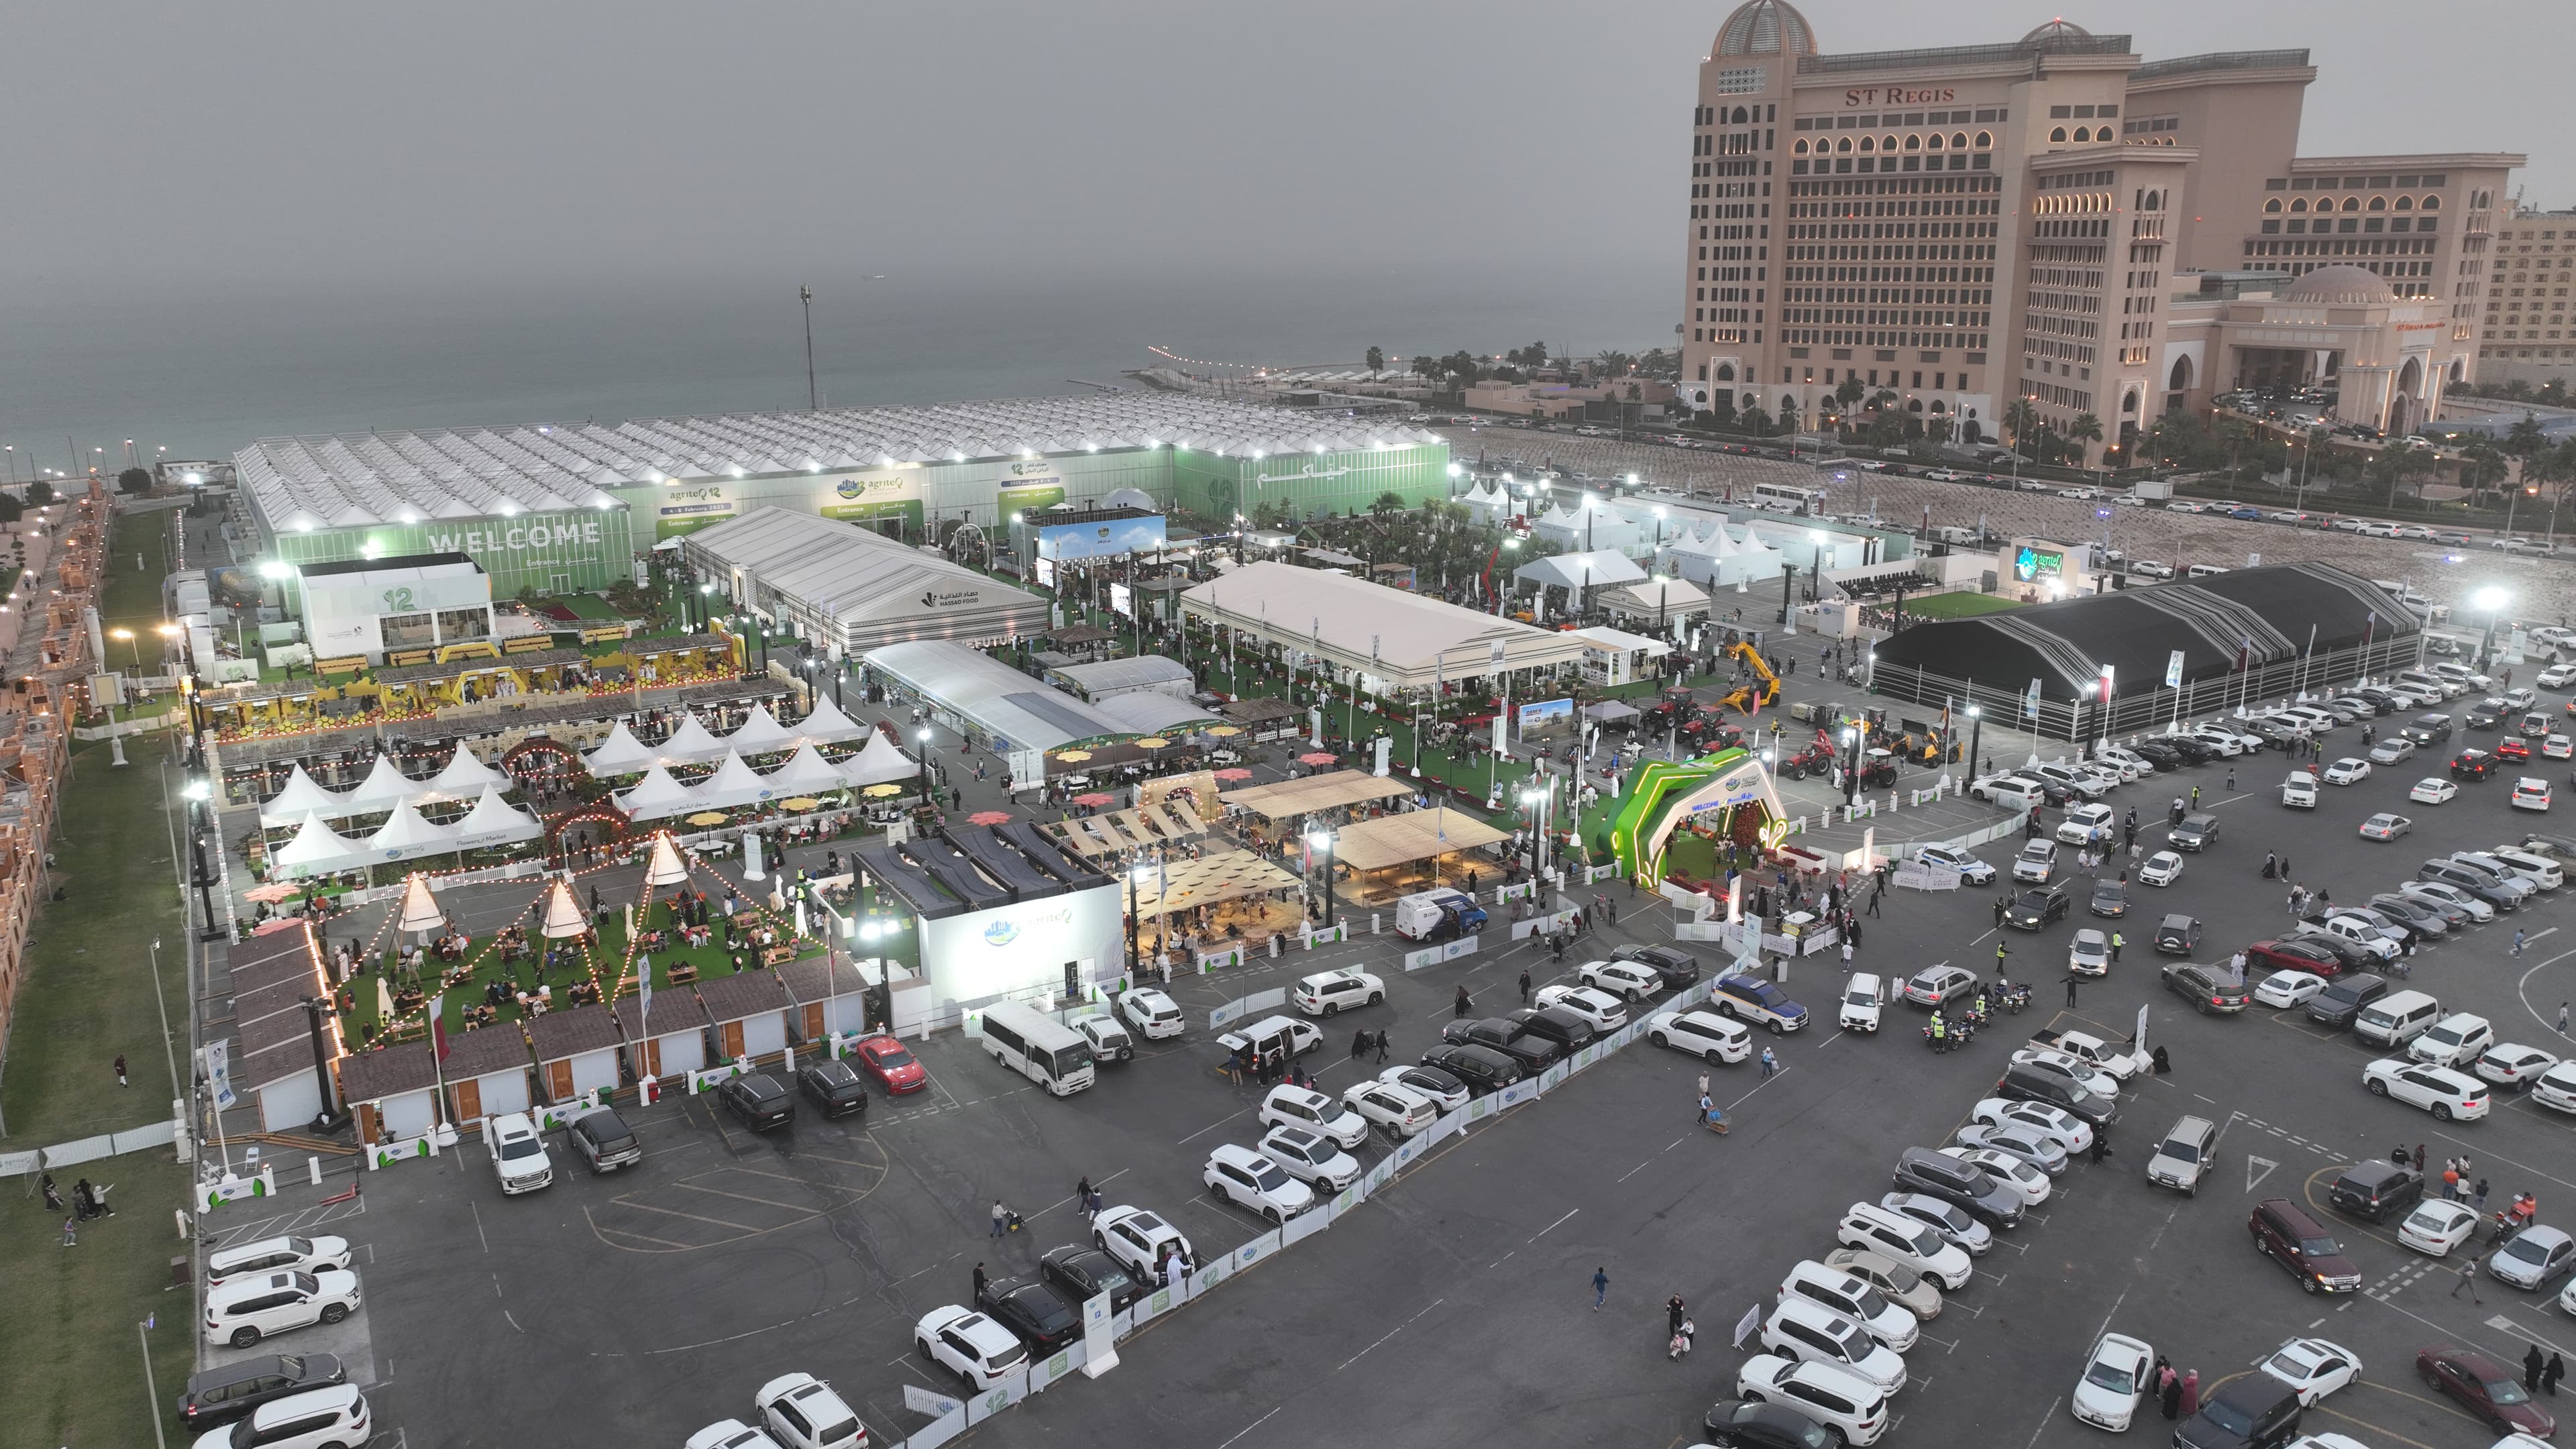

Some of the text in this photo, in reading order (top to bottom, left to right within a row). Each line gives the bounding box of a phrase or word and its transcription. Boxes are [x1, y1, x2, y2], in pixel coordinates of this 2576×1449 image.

[1886, 88, 1954, 104] REGIS
[869, 477, 903, 489] agriteQ
[670, 487, 721, 501] agriteQ 12
[429, 522, 600, 553] WELCOME
[526, 559, 559, 567] Entrance
[383, 588, 418, 611] 12
[939, 592, 962, 600] الغذائية
[940, 599, 962, 607] HASSAD
[1692, 800, 1719, 812] WELCOME
[486, 834, 506, 842] Market
[1051, 1361, 1066, 1372] 2025
[986, 1389, 1009, 1415] 12
